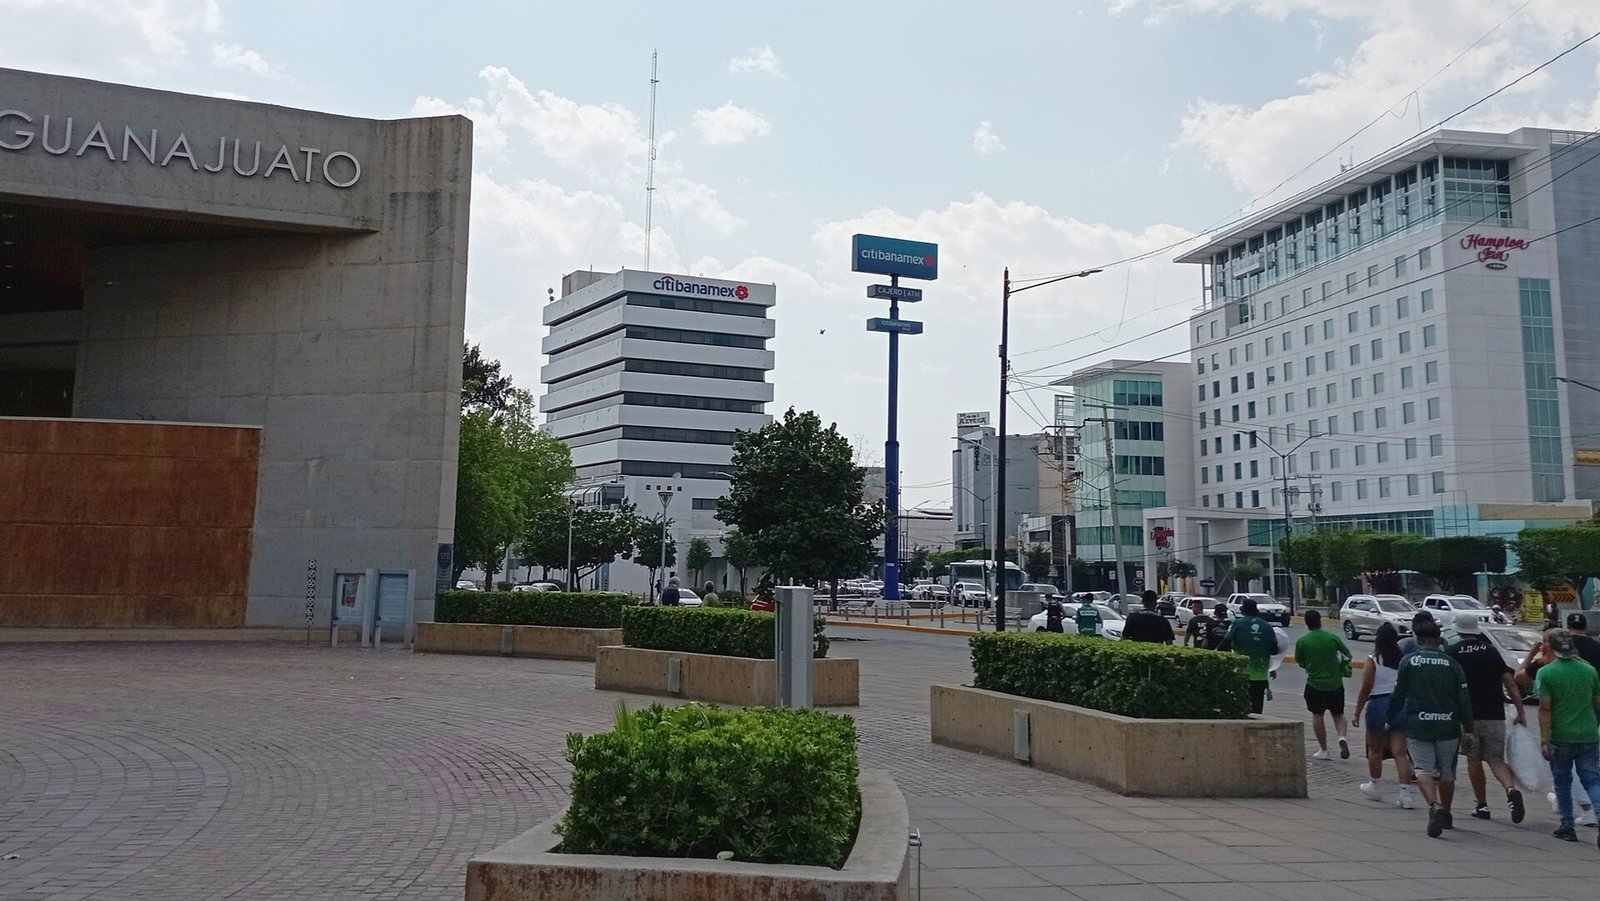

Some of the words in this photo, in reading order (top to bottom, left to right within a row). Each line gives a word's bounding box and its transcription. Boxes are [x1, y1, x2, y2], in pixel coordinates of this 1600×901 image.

[0, 109, 362, 188] GUANAJUATO
[1461, 233, 1529, 250] Hampton
[861, 248, 925, 265] citibanamex
[1478, 247, 1509, 262] Inn
[653, 276, 735, 298] citibanamex
[878, 286, 903, 296] CAJERO
[907, 289, 920, 297] ATM
[1410, 655, 1450, 667] Corona
[1418, 711, 1453, 721] Comex
